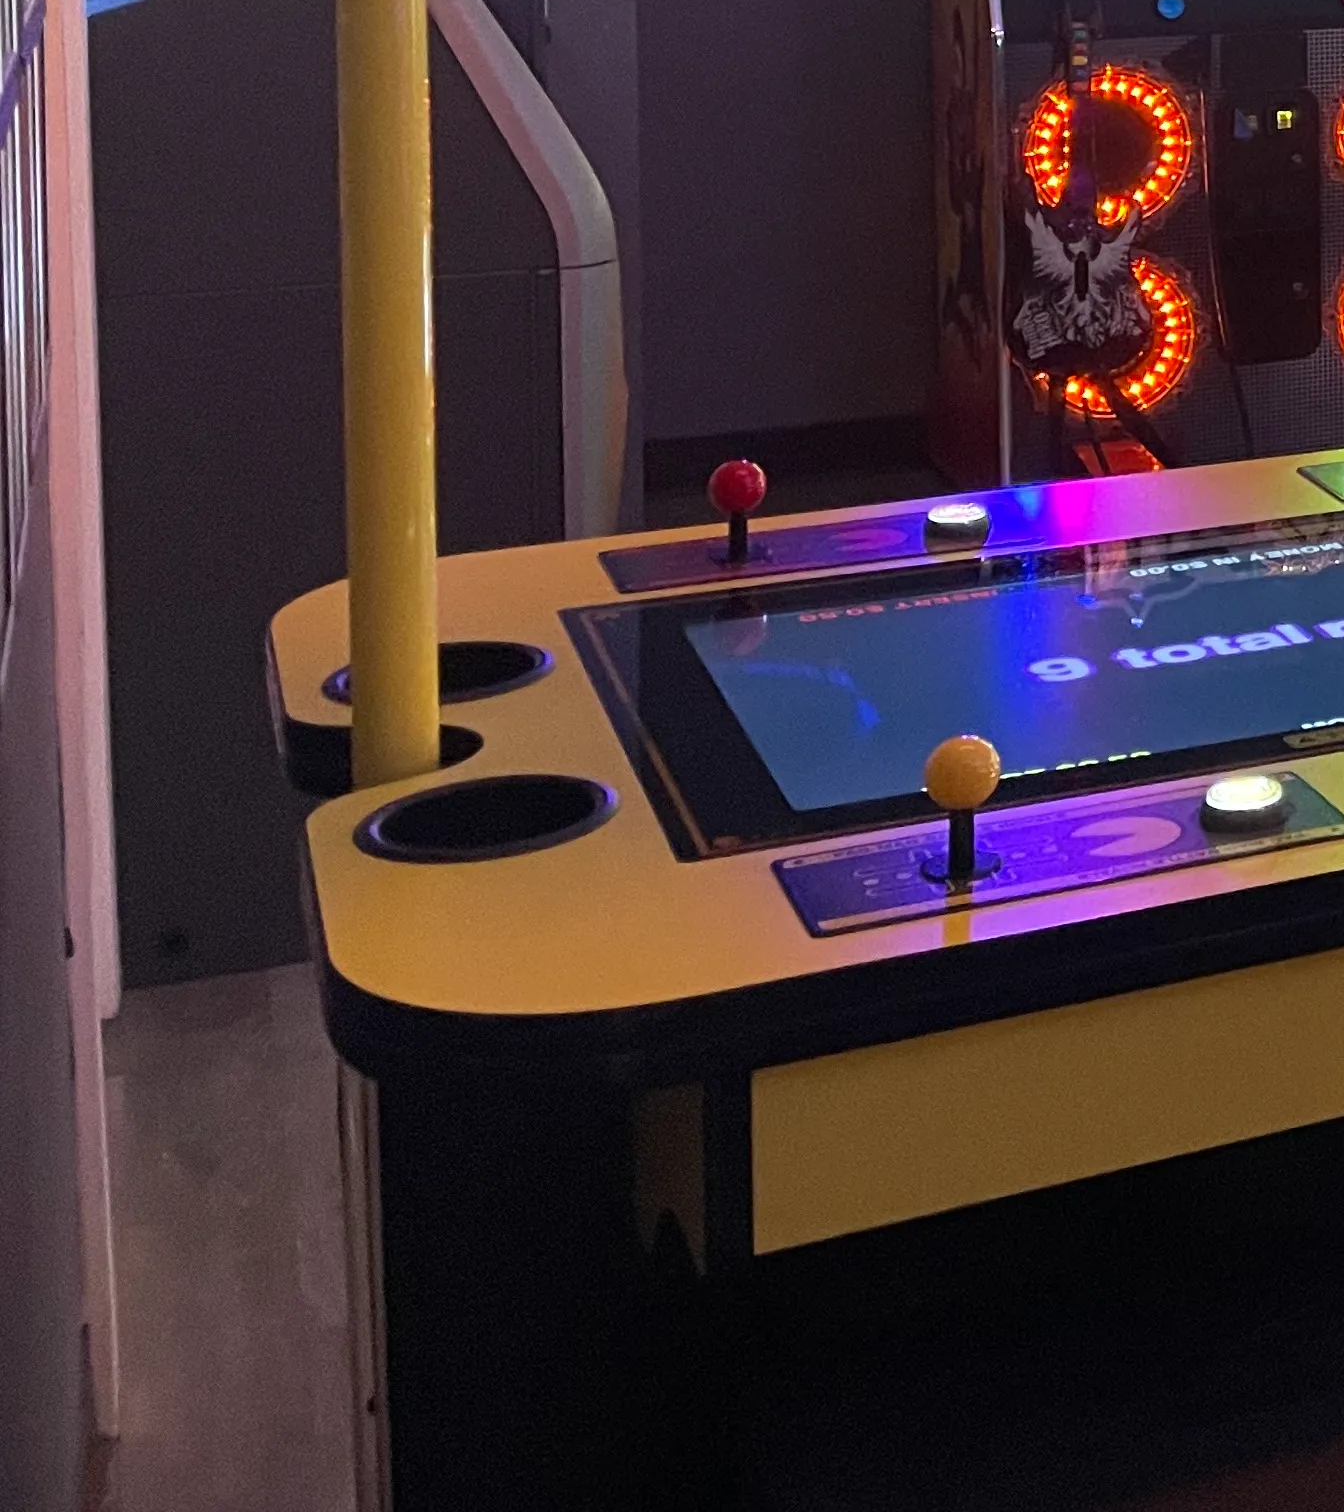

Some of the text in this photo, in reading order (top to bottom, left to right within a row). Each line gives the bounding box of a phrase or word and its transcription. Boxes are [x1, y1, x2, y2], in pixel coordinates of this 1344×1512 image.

[1250, 542, 1344, 562] MONEY
[1027, 654, 1092, 683] 9
[1113, 623, 1313, 671] total
